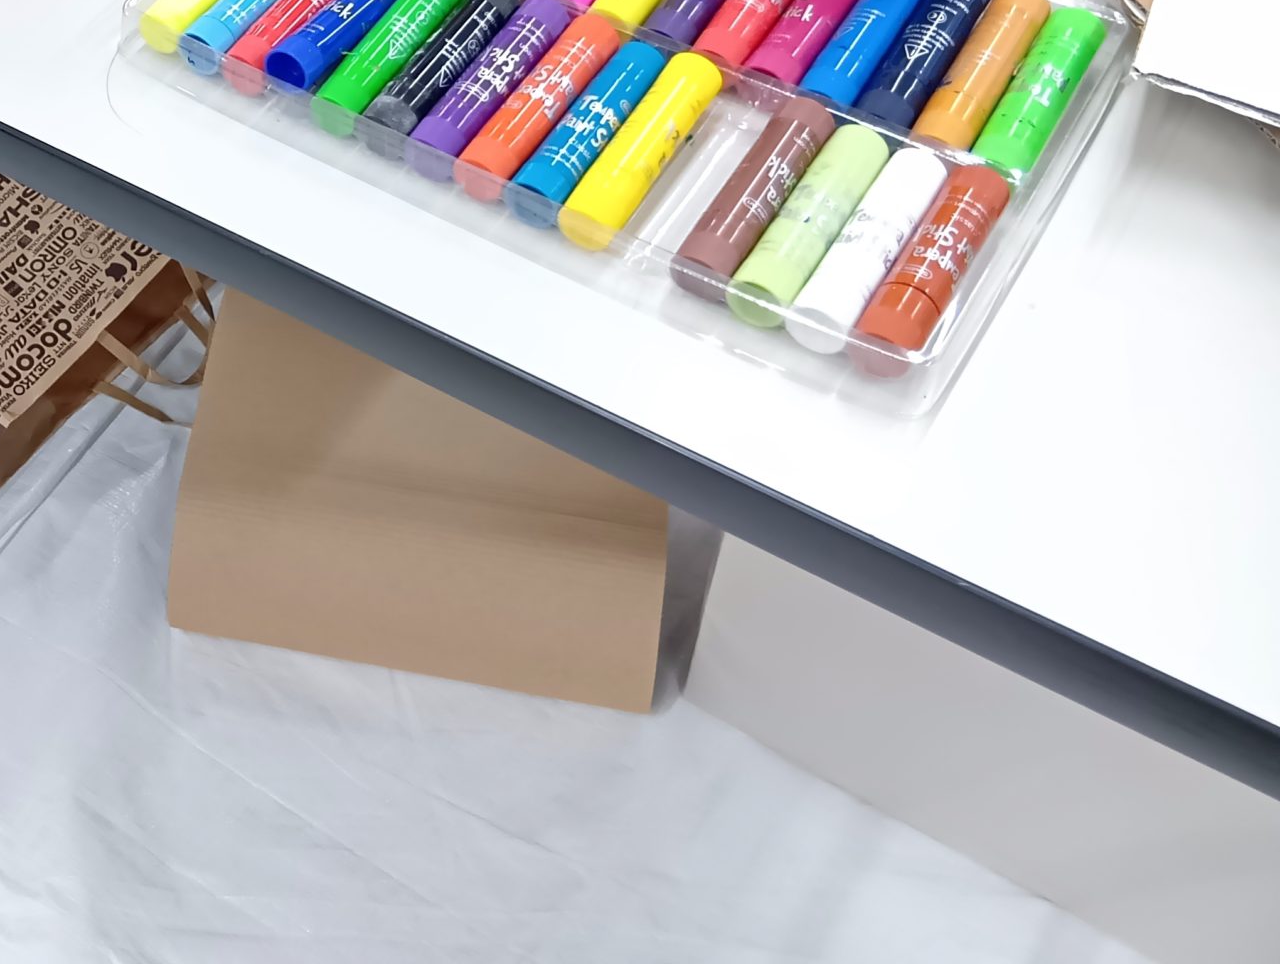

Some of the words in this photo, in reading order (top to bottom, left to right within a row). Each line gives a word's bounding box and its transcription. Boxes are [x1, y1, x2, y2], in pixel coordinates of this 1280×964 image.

[18, 227, 78, 282] OMRON
[41, 248, 73, 282] SONY
[14, 282, 41, 306] Lexar
[63, 263, 102, 300] imation
[68, 279, 103, 313] TWINBIRD
[8, 289, 47, 322] DATA
[13, 355, 55, 395] SEIKO
